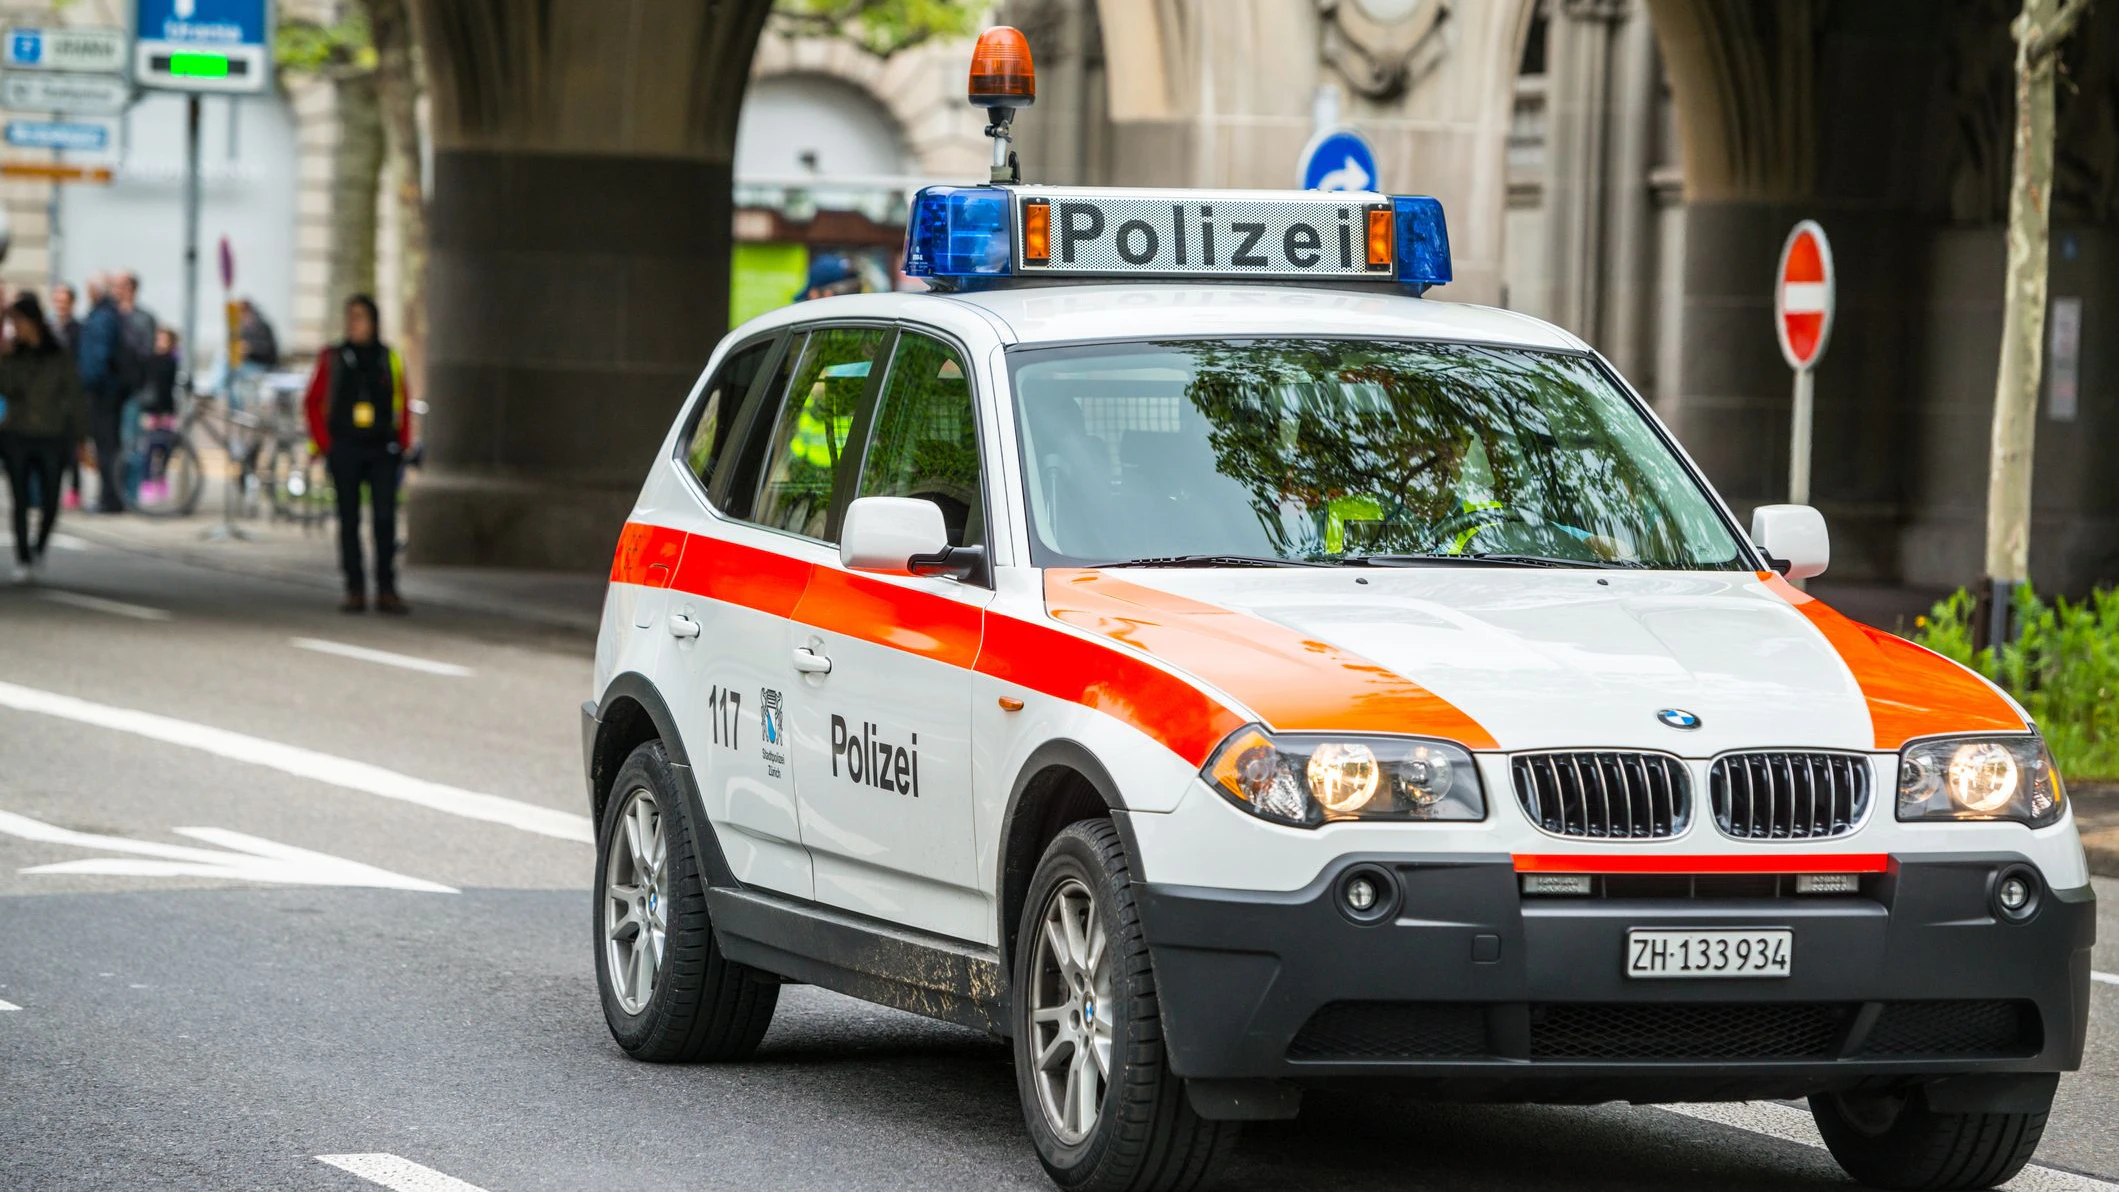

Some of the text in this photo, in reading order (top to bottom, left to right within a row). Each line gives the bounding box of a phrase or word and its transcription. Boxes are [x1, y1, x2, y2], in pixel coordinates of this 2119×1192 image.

[1060, 202, 1353, 268] Polizei
[709, 685, 741, 750] 117
[831, 714, 919, 798] Polizei
